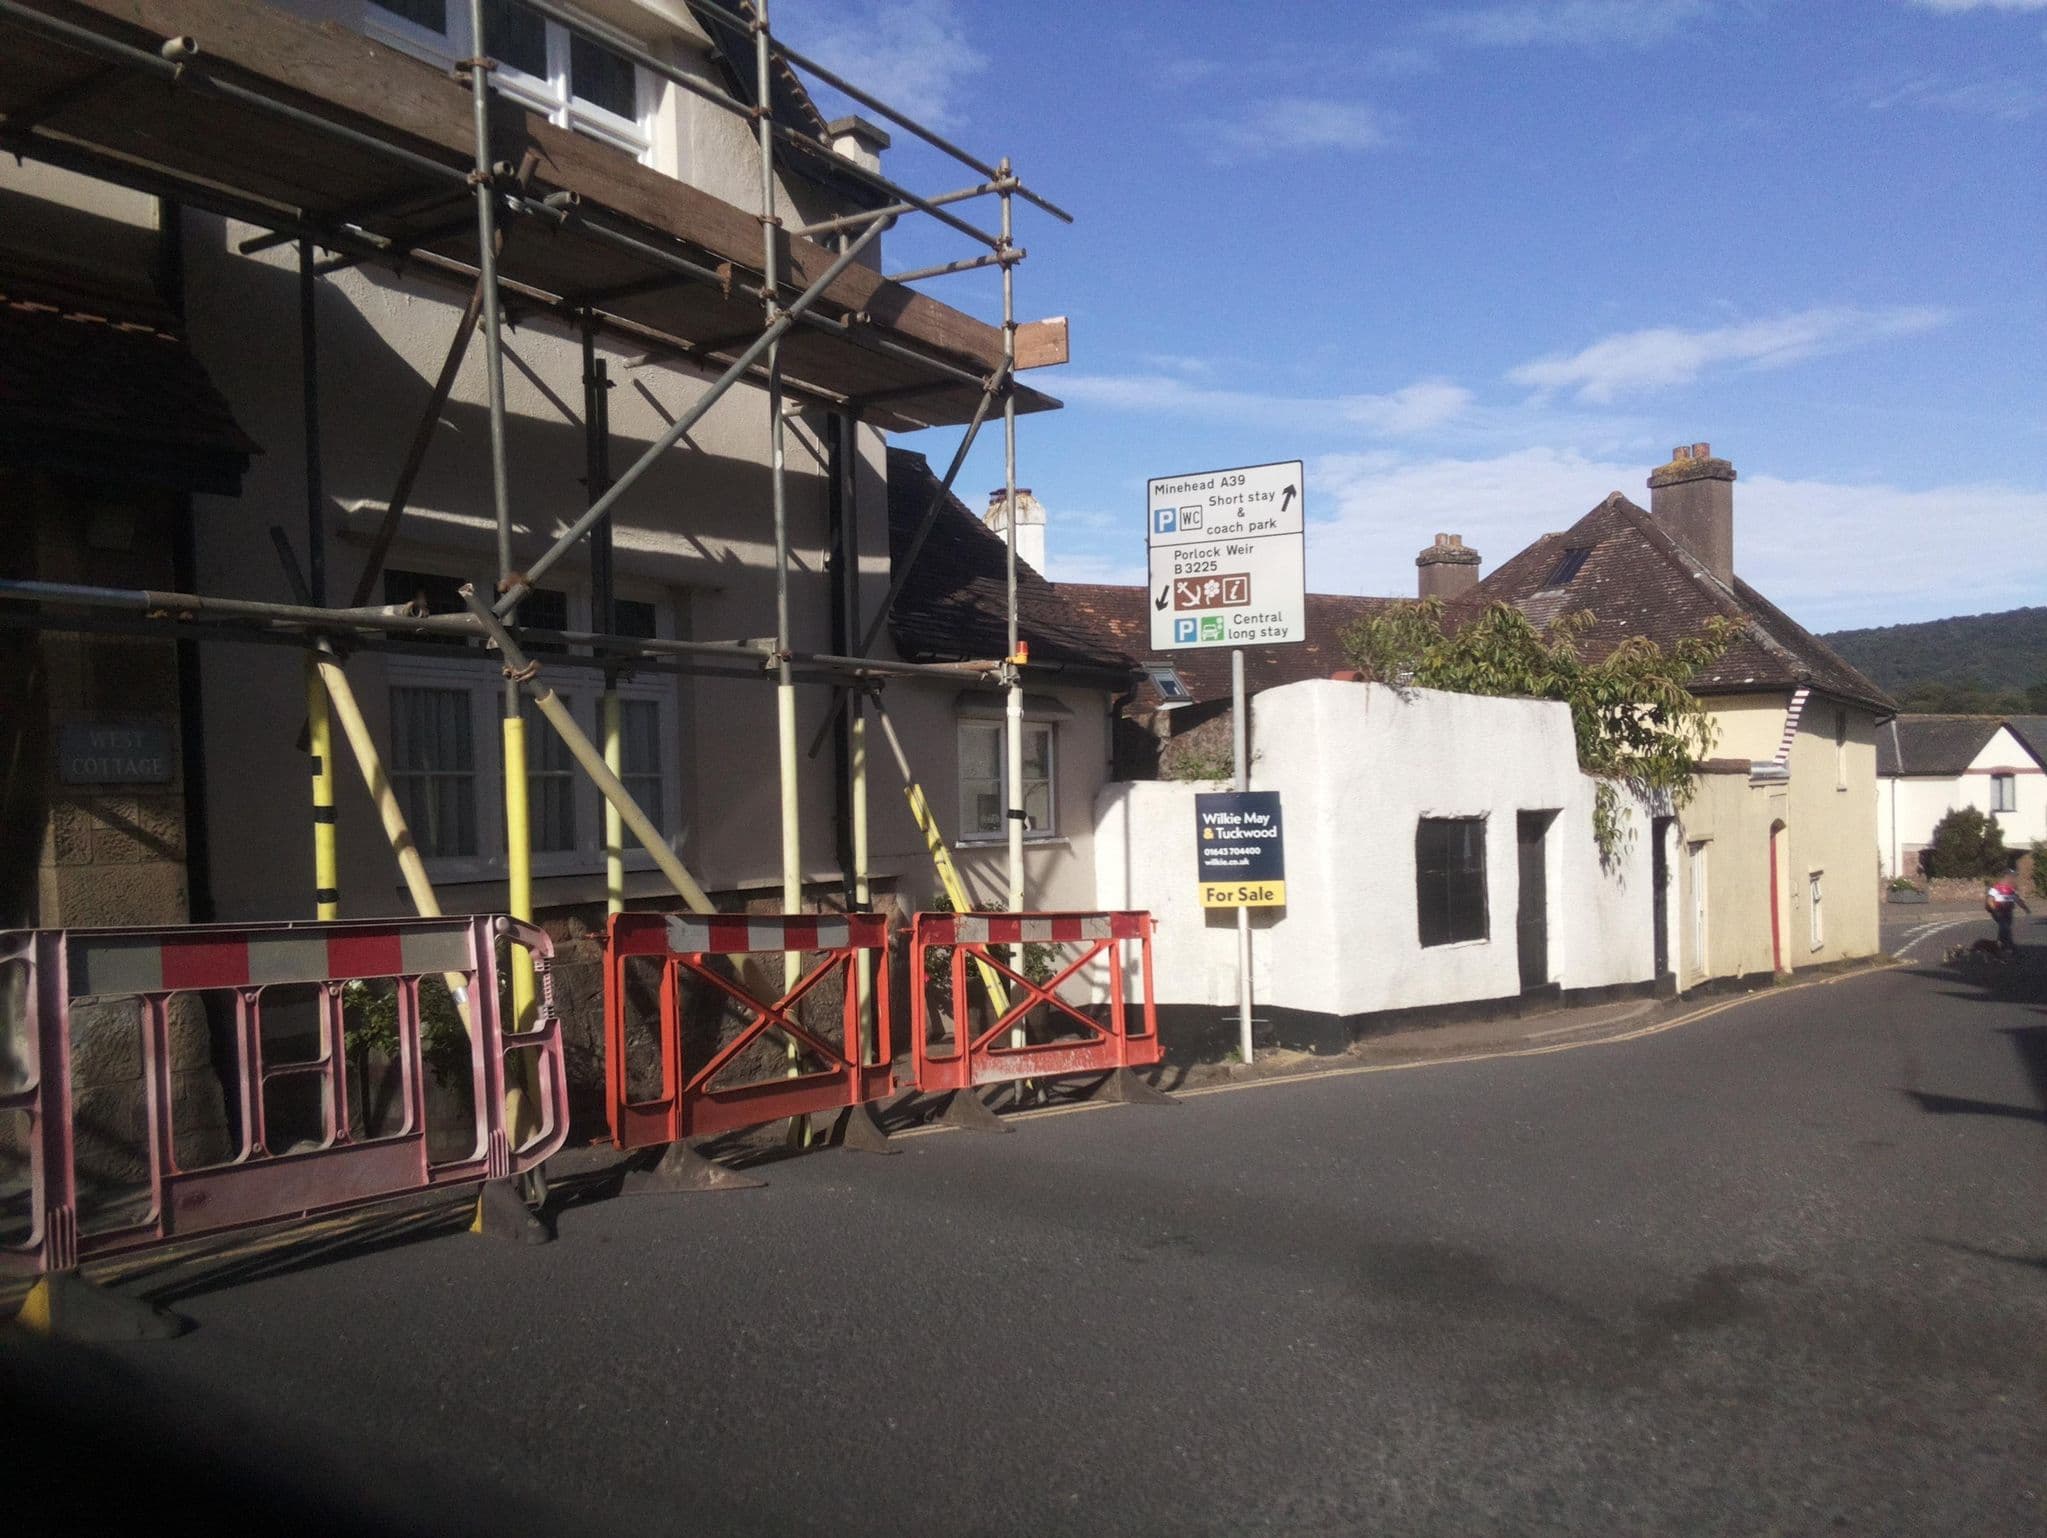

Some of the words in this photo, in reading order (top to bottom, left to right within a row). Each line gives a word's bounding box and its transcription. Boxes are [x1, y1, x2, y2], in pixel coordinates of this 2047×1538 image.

[1155, 479, 1214, 495] Minehead
[1221, 474, 1246, 488] A39
[1208, 494, 1244, 507] Short
[1248, 490, 1275, 503] stay
[1182, 511, 1200, 526] WC
[1237, 507, 1246, 518] &
[1207, 522, 1243, 535] coach
[1248, 518, 1277, 532] park
[1174, 548, 1220, 560] Porlock
[1226, 544, 1255, 556] Weir
[1233, 611, 1283, 625] Central
[1228, 628, 1256, 641] long
[1260, 626, 1289, 639] stay
[88, 731, 145, 750] WEST
[72, 758, 162, 776] COTTAGE
[1202, 813, 1242, 824] Wilkie
[1243, 812, 1270, 826] May
[1203, 827, 1214, 840] &
[1216, 826, 1277, 839] Tuckwood
[1203, 847, 1228, 856] 01643
[1206, 887, 1234, 902] For
[1238, 886, 1274, 901] Sale
